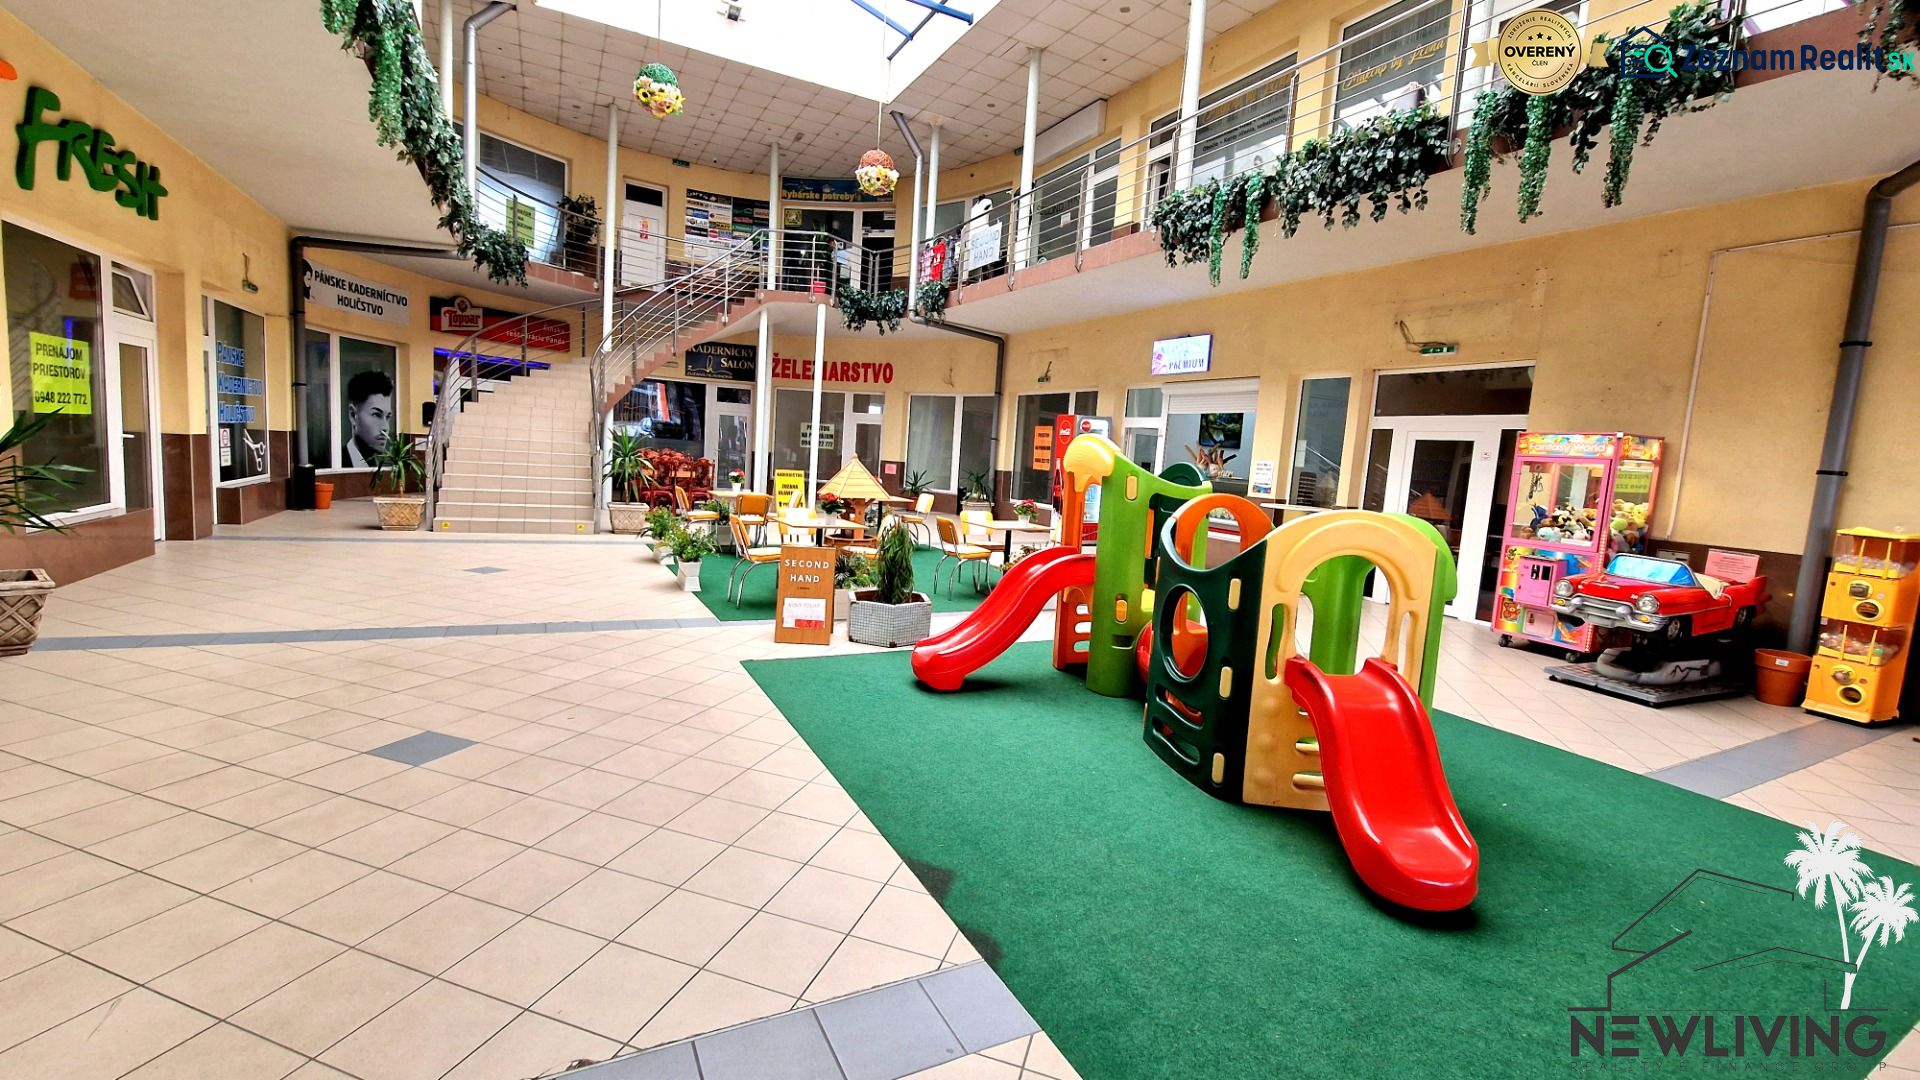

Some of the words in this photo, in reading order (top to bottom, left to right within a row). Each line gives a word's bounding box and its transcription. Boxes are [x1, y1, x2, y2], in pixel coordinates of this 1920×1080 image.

[822, 191, 855, 202] potreby
[973, 247, 994, 263] HAND
[314, 270, 346, 291] PÁNSKE
[347, 281, 408, 307] KADERNÍCTVO
[337, 294, 384, 316] HOLIČSTVO
[35, 342, 83, 361] PRENÁJOM
[720, 357, 755, 369] SALÓN
[771, 352, 894, 384] ŽELEIARSTVO
[33, 362, 86, 380] PRIESTOROV
[34, 390, 56, 403] 0948
[57, 392, 72, 404] 222
[73, 393, 88, 405] 772
[1529, 441, 1570, 454] Fantasy
[1574, 441, 1606, 453] World
[784, 559, 829, 569] SECOND
[790, 574, 820, 583] HAND
